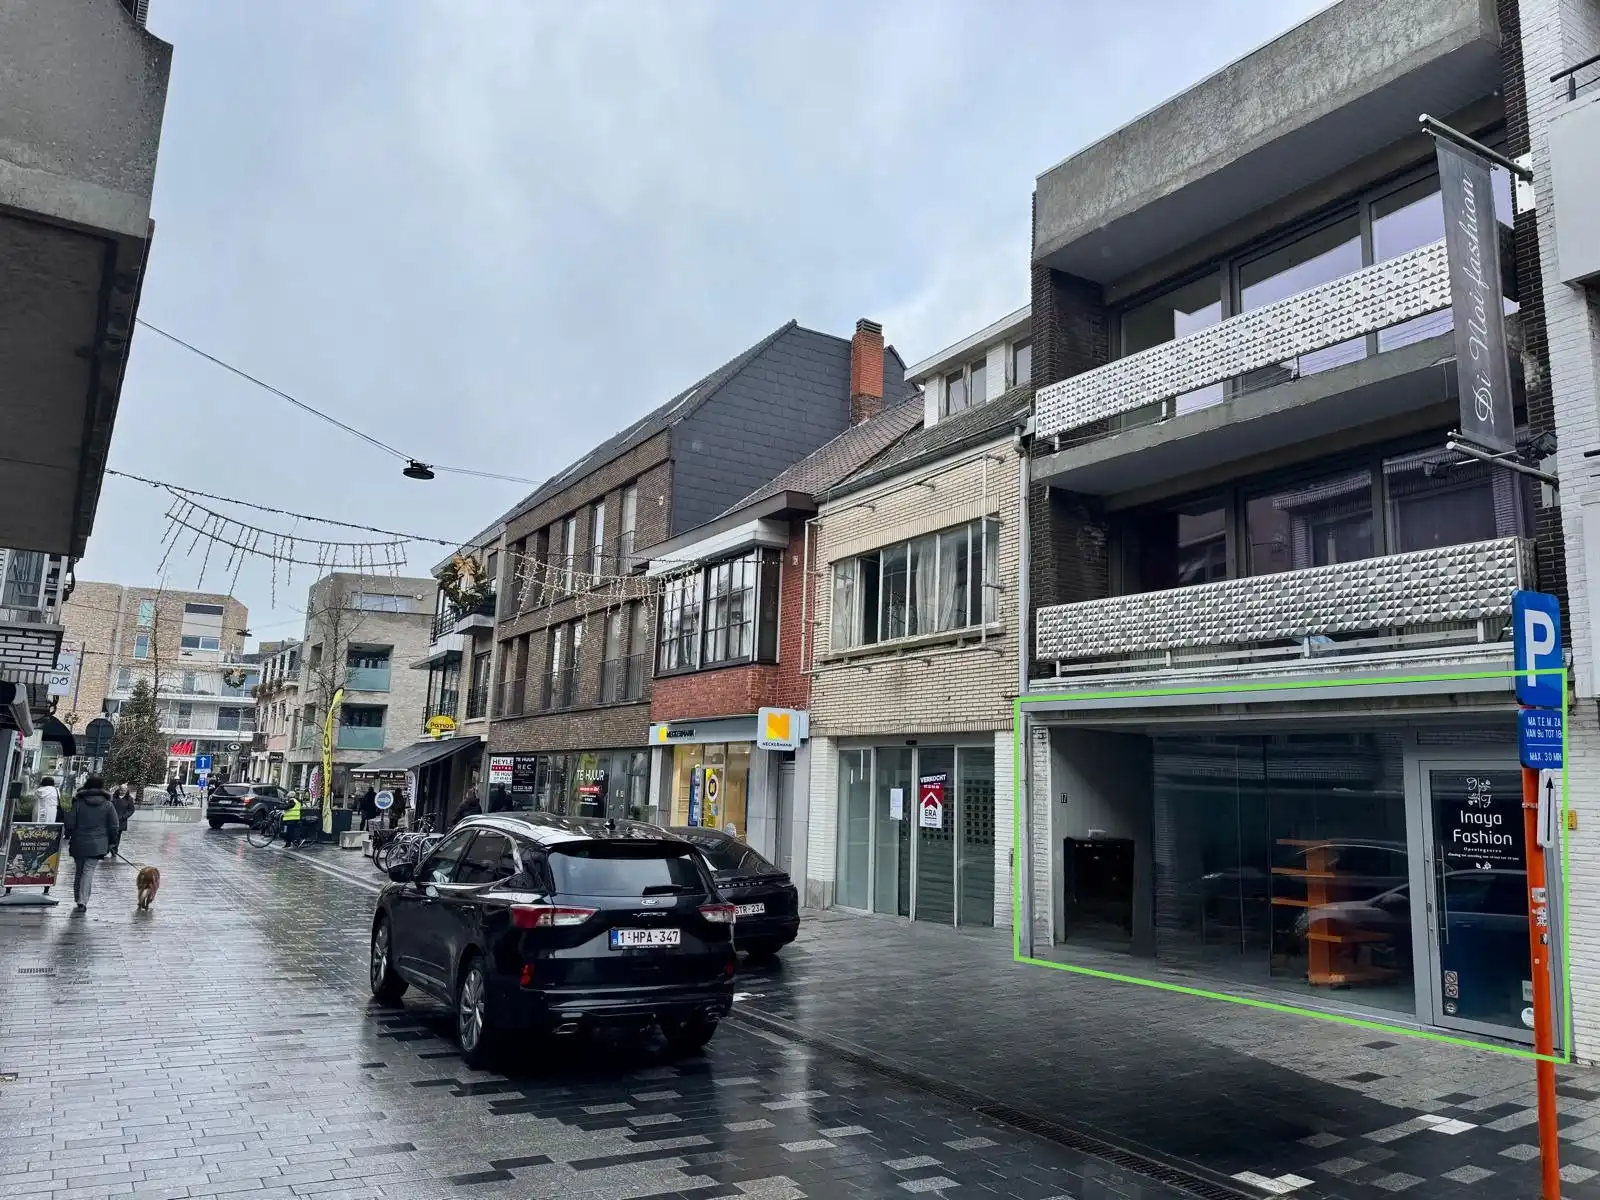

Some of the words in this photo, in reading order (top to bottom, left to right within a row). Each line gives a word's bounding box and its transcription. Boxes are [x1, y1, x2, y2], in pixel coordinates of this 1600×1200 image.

[1458, 172, 1490, 292] fashion
[1468, 291, 1490, 361] Noi
[1473, 368, 1494, 425] Di
[1524, 608, 1556, 687] P
[1554, 717, 1562, 727] ZA
[1525, 728, 1536, 738] VAN
[1545, 729, 1555, 738] TOT
[1544, 752, 1553, 762] 30
[577, 769, 584, 780] TE
[585, 769, 605, 781] HUUR
[920, 774, 946, 783] VERKOCHT
[1460, 810, 1502, 828] Inaya
[1453, 829, 1513, 846] Fashion
